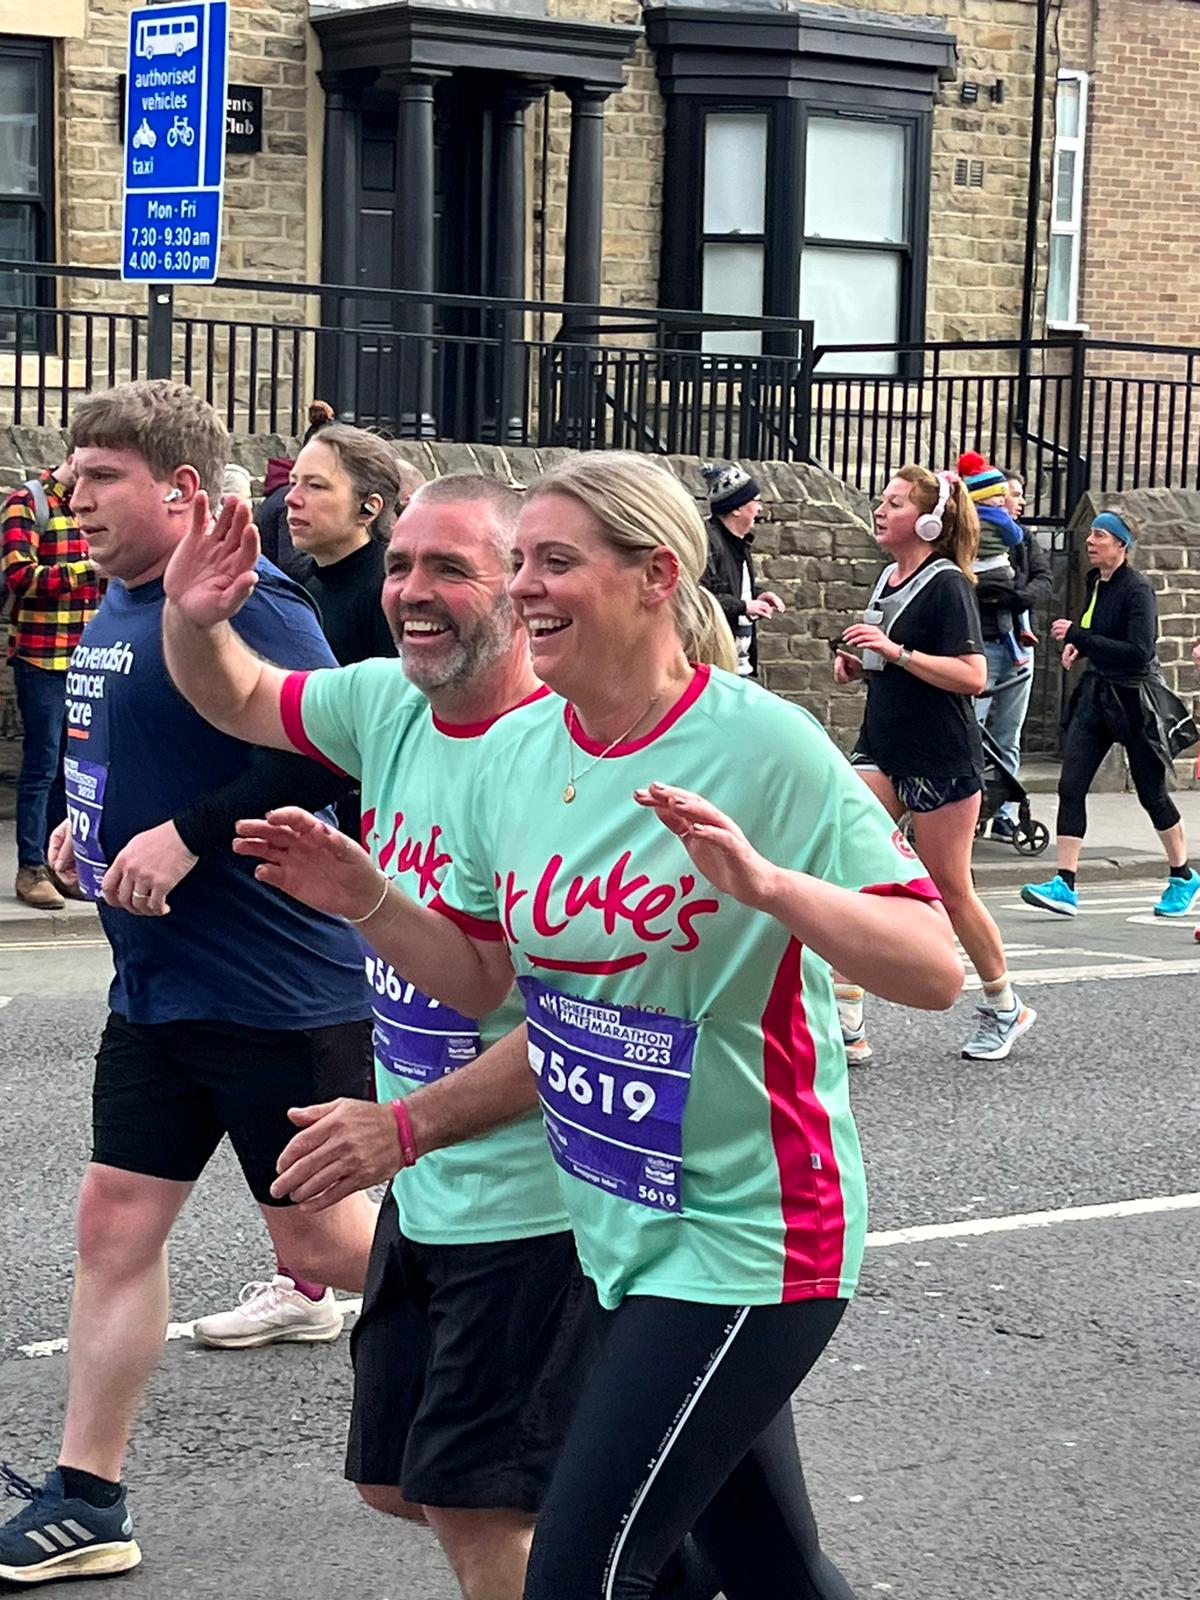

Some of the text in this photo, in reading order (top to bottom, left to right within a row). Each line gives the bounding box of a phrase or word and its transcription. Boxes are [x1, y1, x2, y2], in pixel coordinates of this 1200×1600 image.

[135, 65, 196, 88] authorised
[142, 91, 188, 111] vehicles
[132, 156, 154, 175] taxi
[66, 671, 105, 699] cancer
[66, 804, 91, 842] 79
[378, 811, 454, 899] Luk
[532, 850, 719, 952] Luke's
[560, 998, 619, 1024] SHEFFIELD
[560, 1012, 672, 1048] HALF MARATHON
[623, 1042, 671, 1065] 2023
[547, 1050, 657, 1123] 5619
[638, 1184, 677, 1206] 5619
